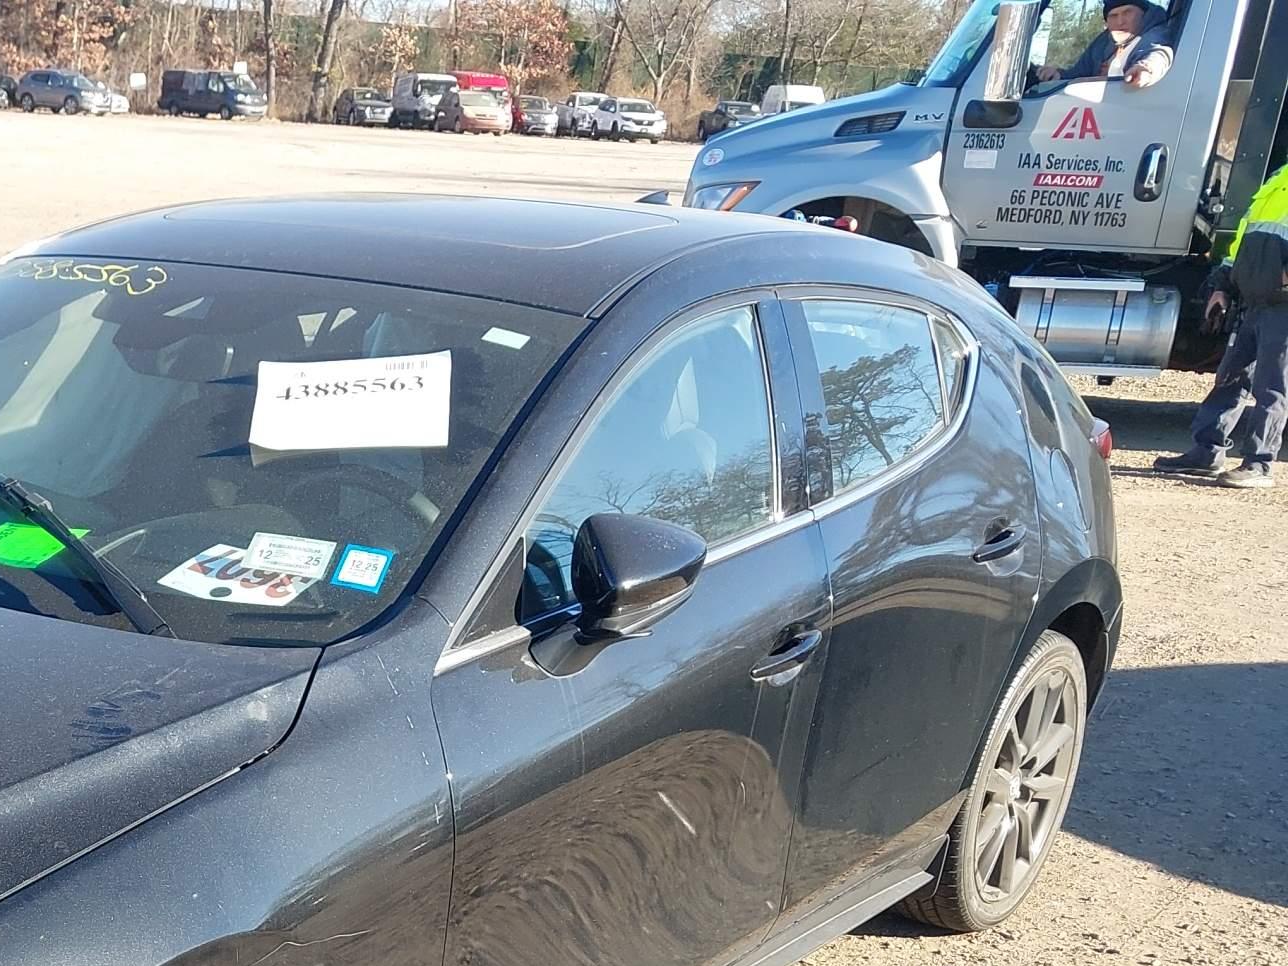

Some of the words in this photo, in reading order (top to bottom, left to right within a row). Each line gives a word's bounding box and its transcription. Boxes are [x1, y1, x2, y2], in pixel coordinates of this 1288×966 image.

[914, 112, 945, 121] MV
[963, 132, 1006, 149] 23162613
[1018, 152, 1042, 169] IAA
[1045, 153, 1102, 172] Services,
[1104, 156, 1126, 173] Inc.
[1037, 174, 1099, 187] IAAI.COM
[1010, 189, 1026, 205] 66
[1030, 190, 1090, 207] PECONIC
[1095, 193, 1124, 209] AVE
[996, 206, 1065, 226] MEDFORD,
[1069, 210, 1090, 225] NY
[1094, 211, 1127, 228] 11763
[275, 375, 425, 401] 43885563
[258, 548, 273, 560] 12
[304, 556, 322, 567] 25
